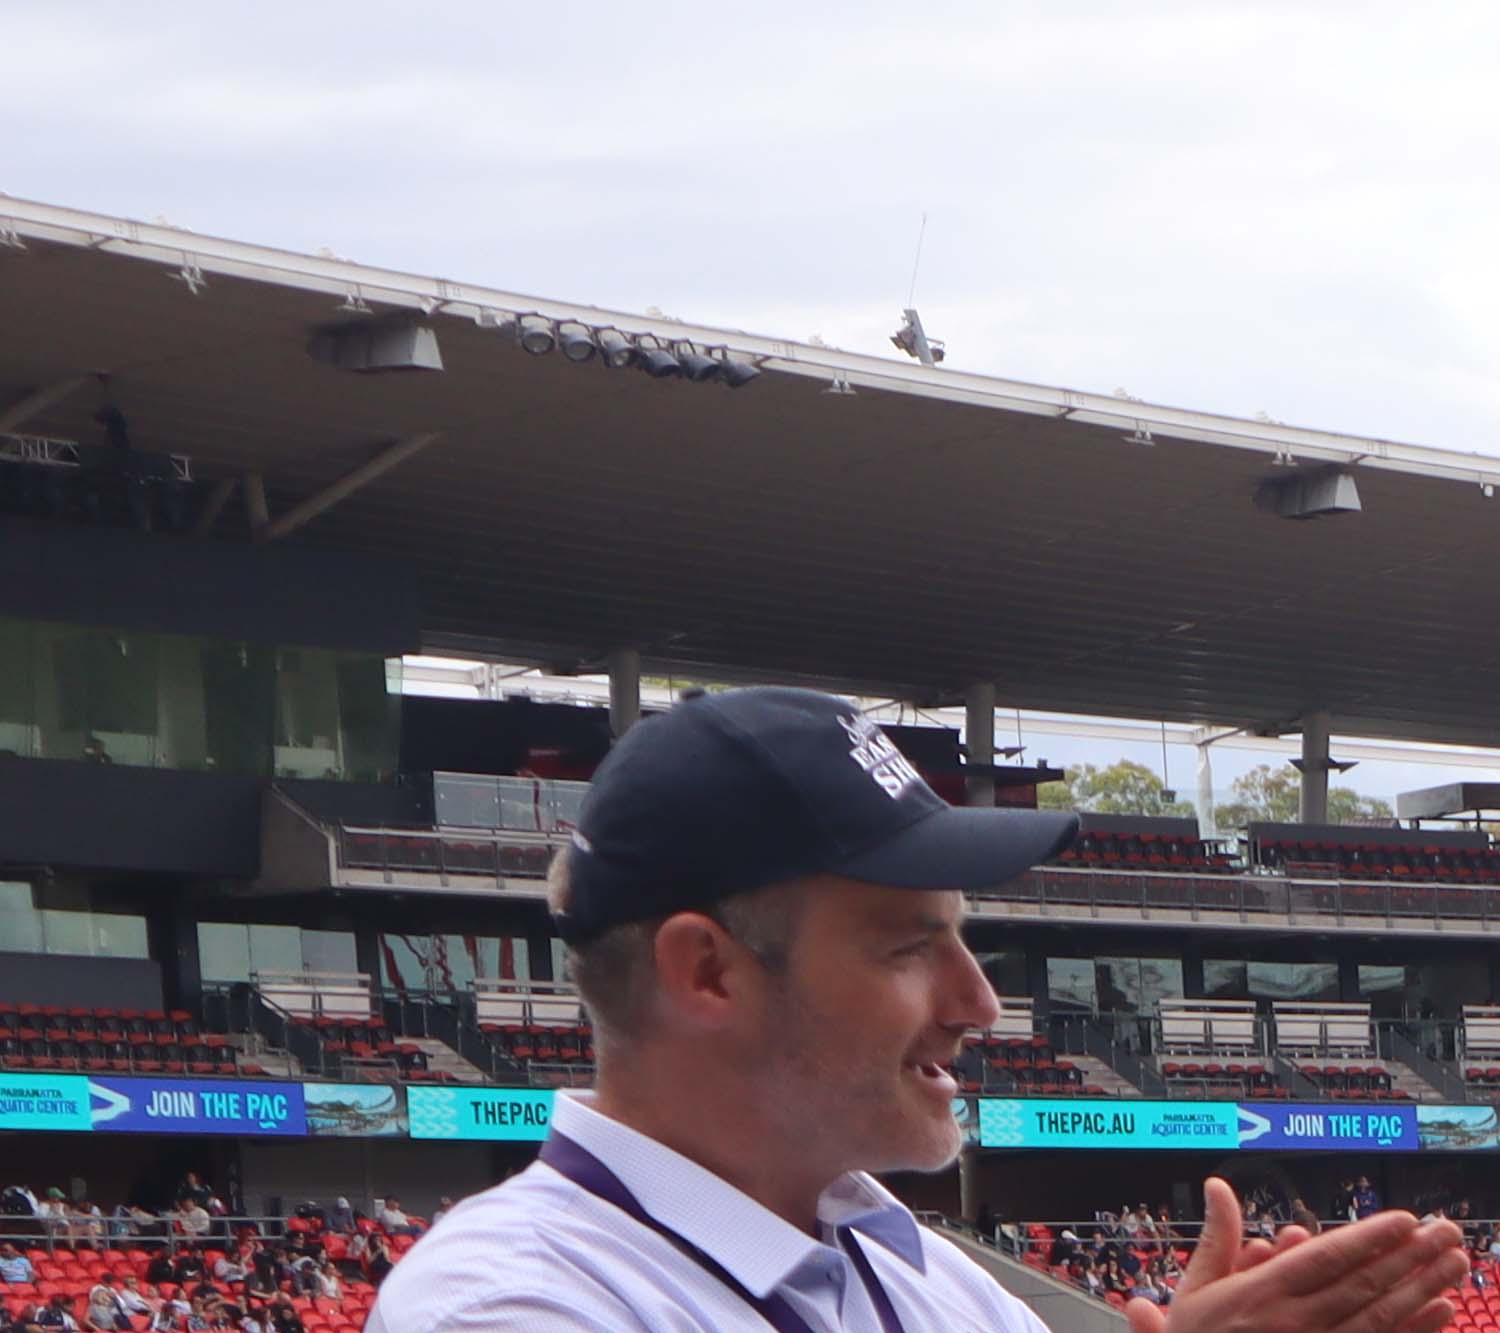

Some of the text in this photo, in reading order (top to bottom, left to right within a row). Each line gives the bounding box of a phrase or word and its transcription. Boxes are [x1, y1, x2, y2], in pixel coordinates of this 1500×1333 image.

[37, 1101, 78, 1114] CENTRE
[146, 1091, 288, 1128] JOIN THE PAC
[470, 1101, 548, 1126] THEPAC
[1036, 1112, 1135, 1135] THEPAC.AU
[1151, 1123, 1228, 1136] AQUATIC CENTRE
[1283, 1114, 1403, 1145] JOIN THE PAC
